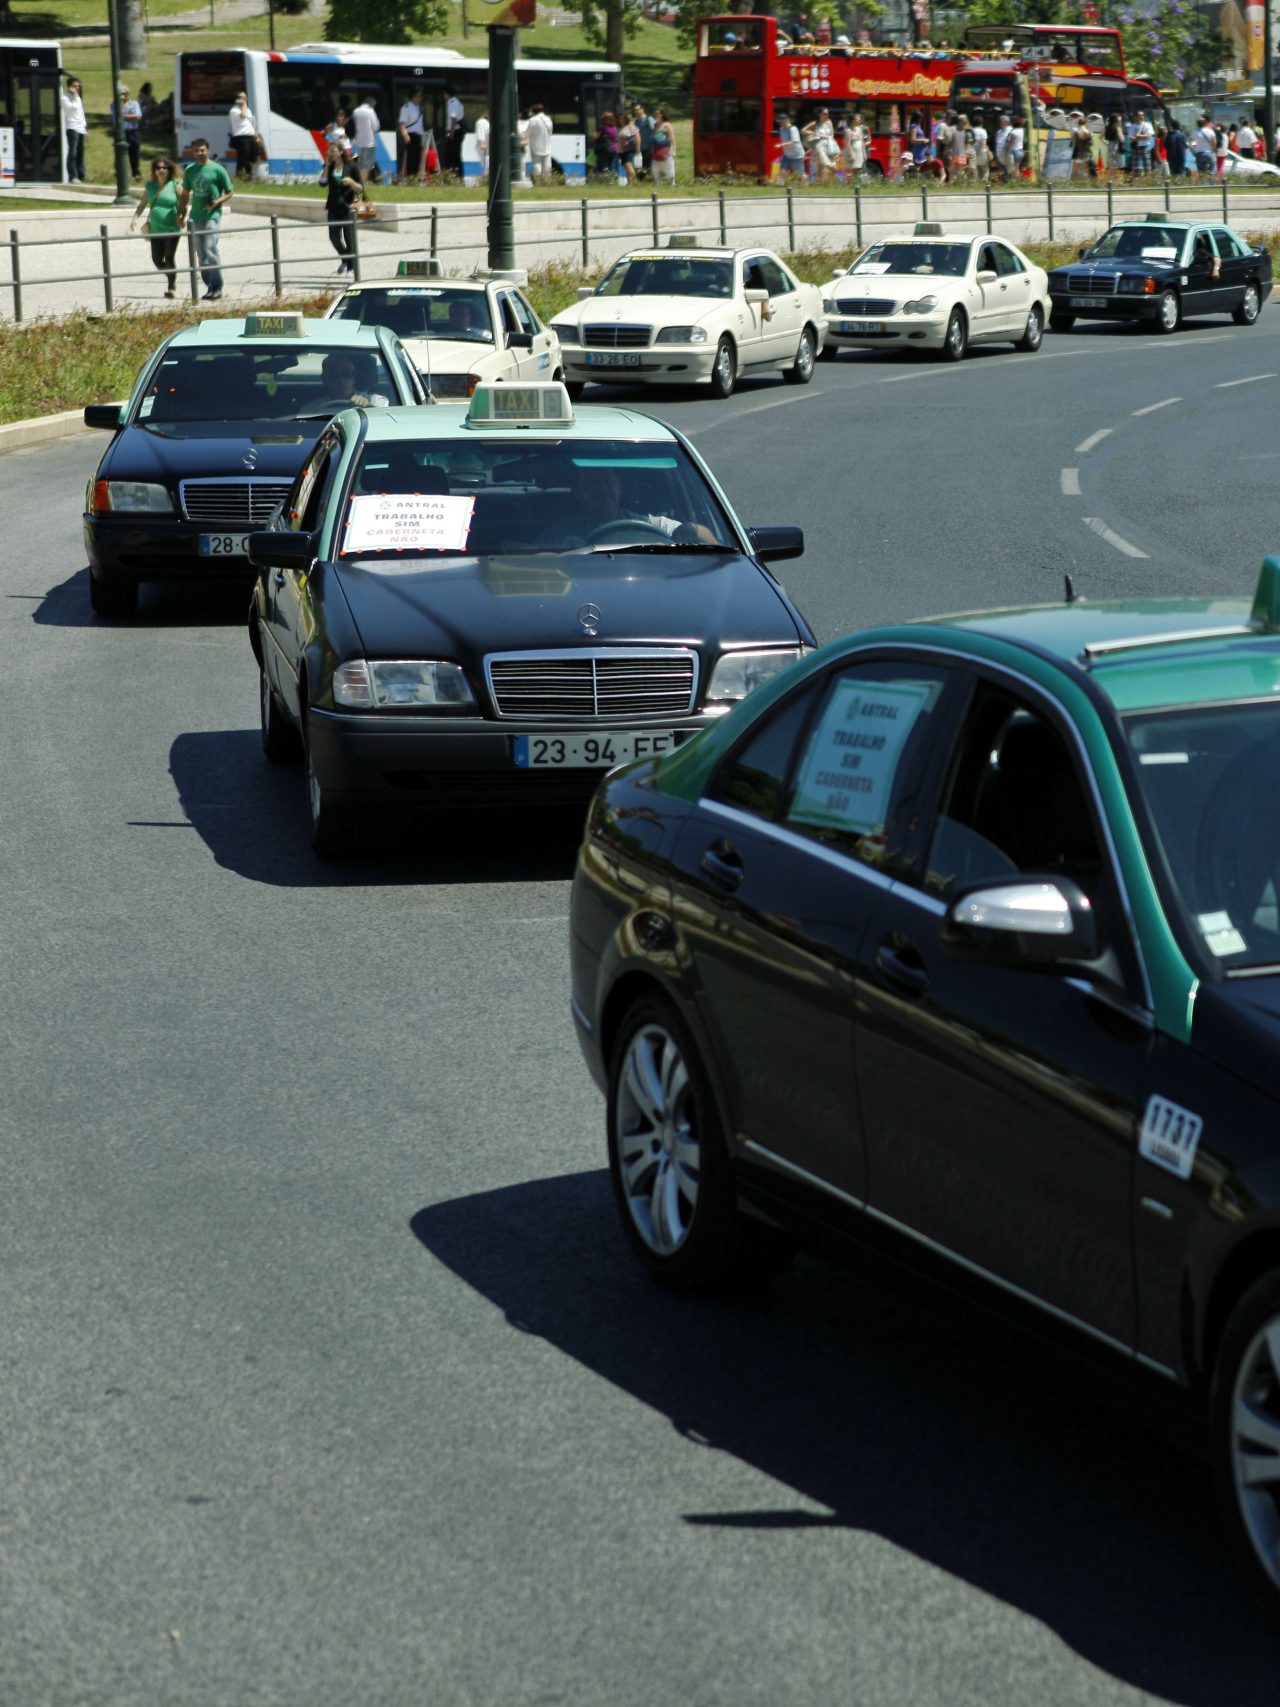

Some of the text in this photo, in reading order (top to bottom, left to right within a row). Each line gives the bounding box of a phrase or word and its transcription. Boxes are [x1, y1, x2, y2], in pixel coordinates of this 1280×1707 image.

[258, 317, 285, 329] TAXI
[495, 390, 538, 410] TAXI
[396, 501, 446, 509] ANTRAL
[374, 513, 444, 521] TRABALHO
[367, 528, 445, 536] CADERNETA
[390, 535, 418, 543] NÃO
[860, 703, 899, 720] ANTRAL
[833, 730, 887, 750] TRABALHO
[841, 754, 863, 769] SIM
[815, 770, 874, 793] CADERNETA
[1149, 1103, 1198, 1152] 1737
